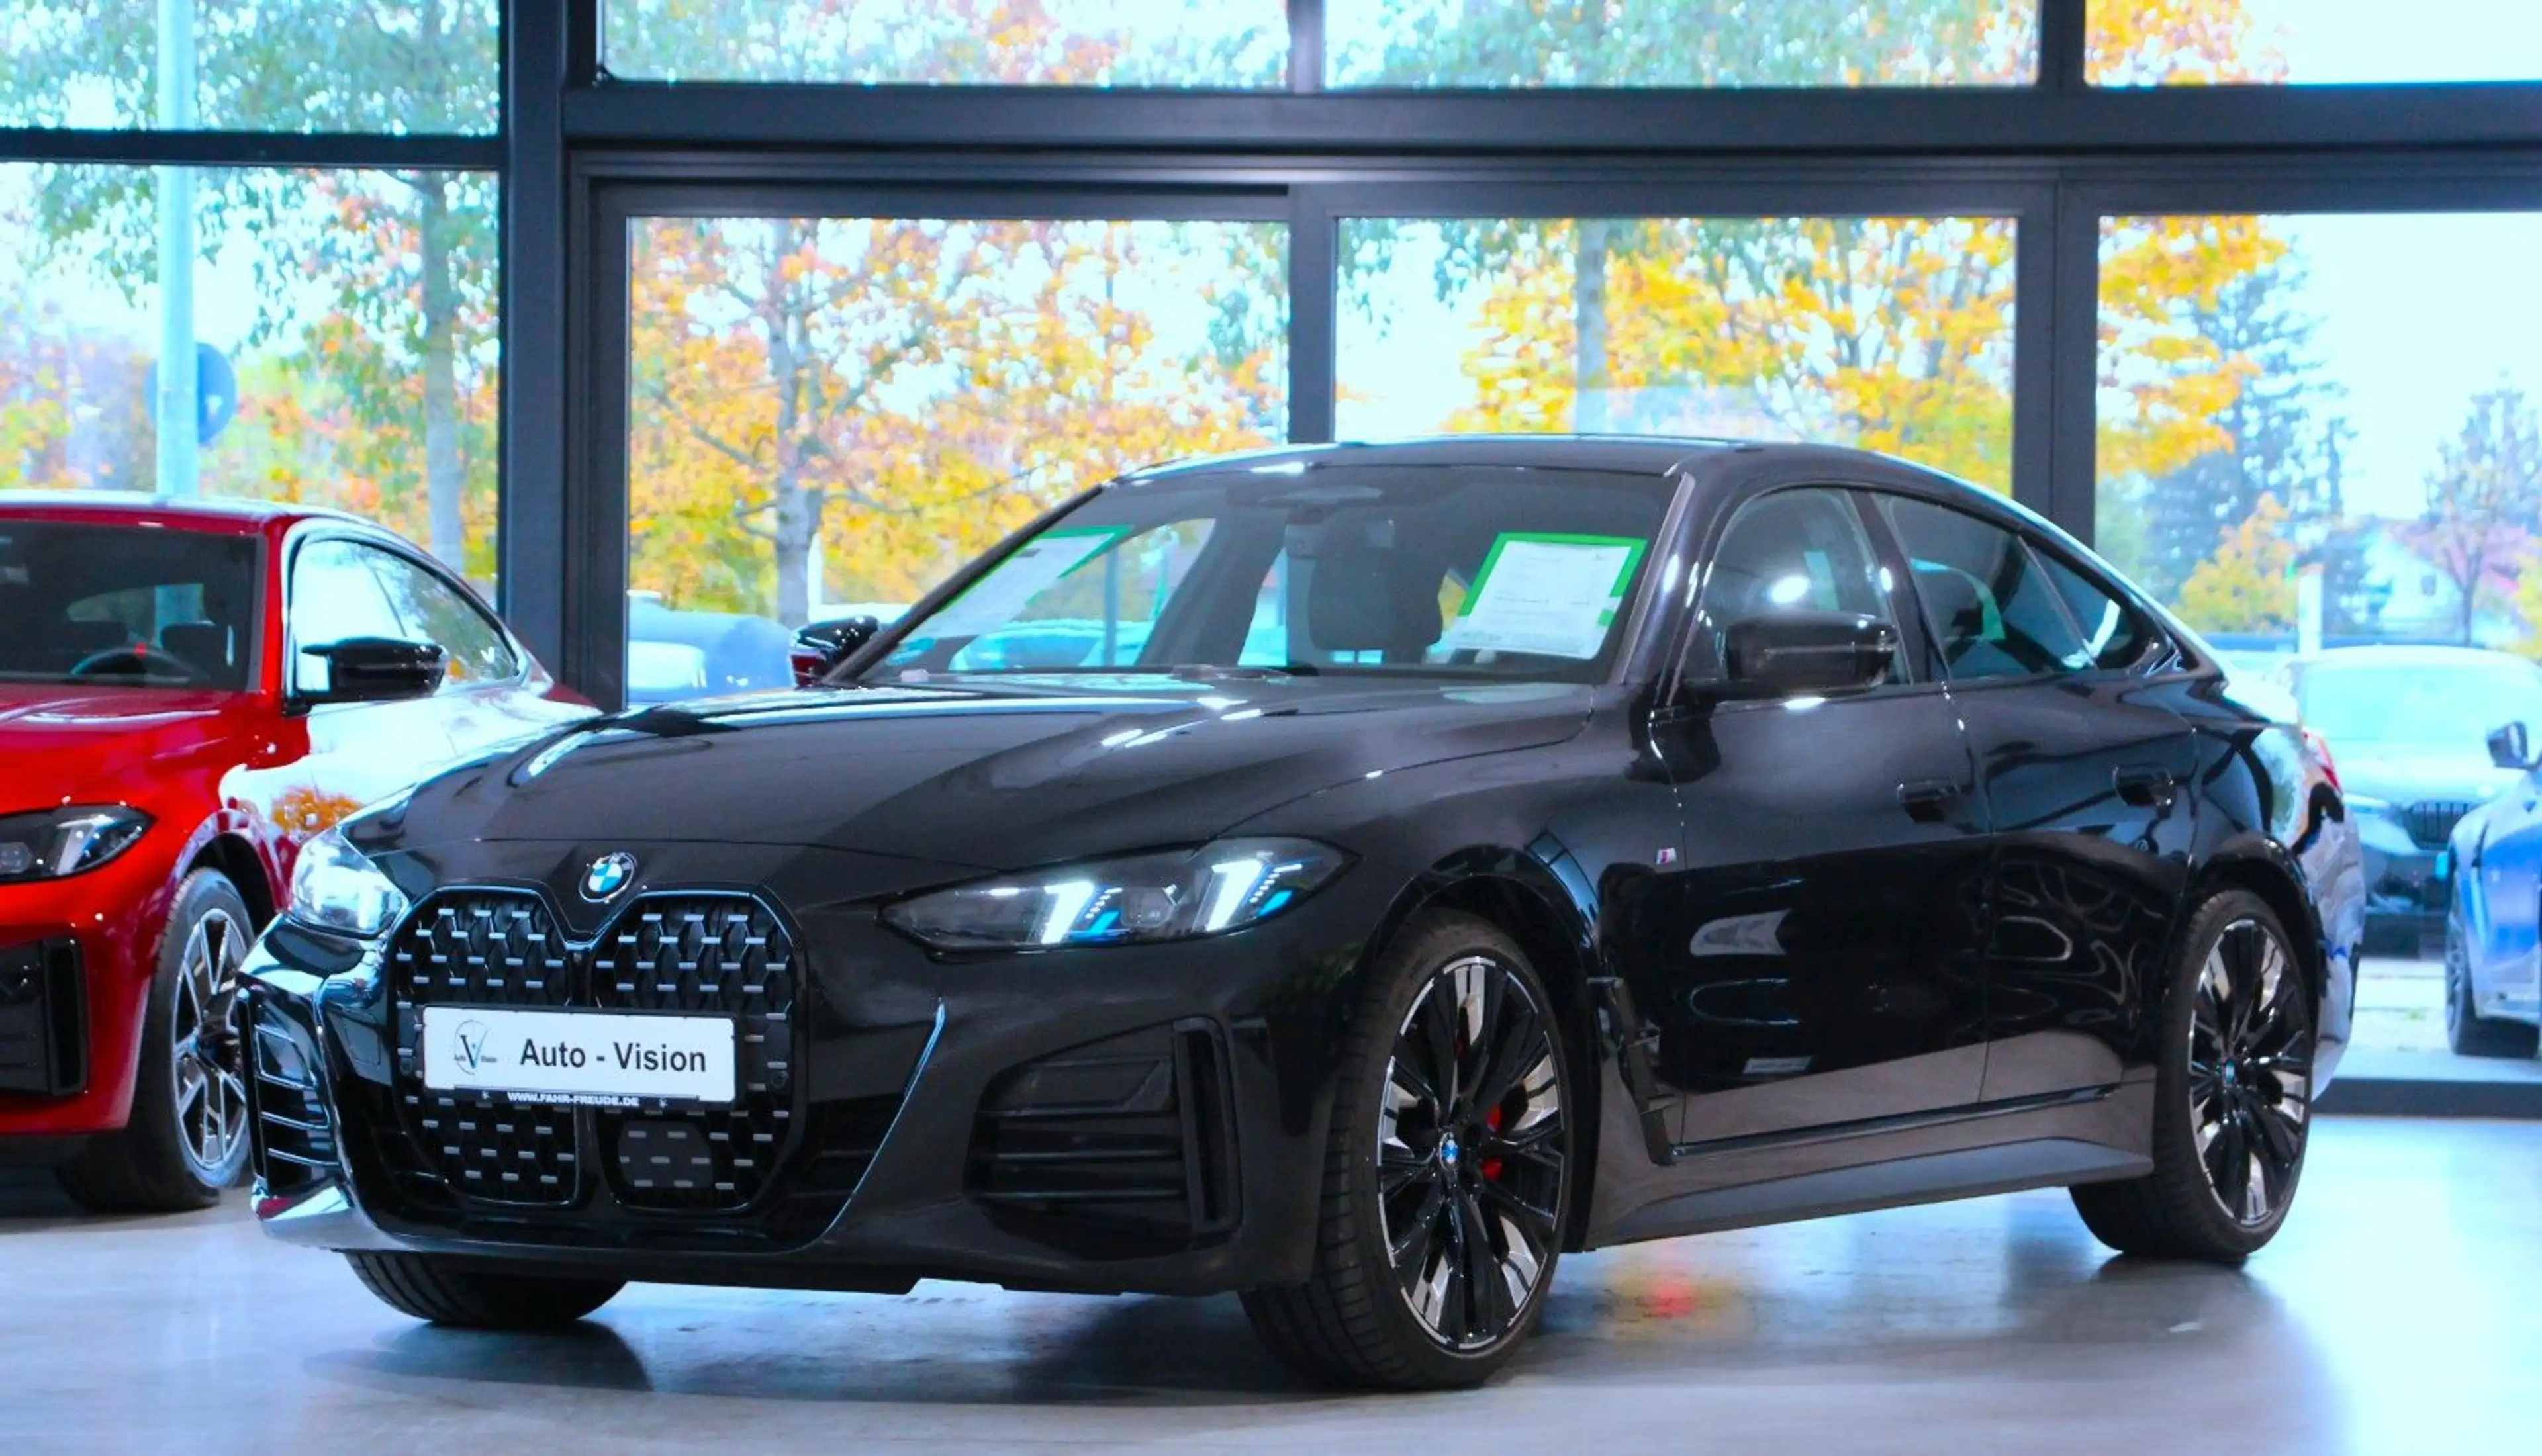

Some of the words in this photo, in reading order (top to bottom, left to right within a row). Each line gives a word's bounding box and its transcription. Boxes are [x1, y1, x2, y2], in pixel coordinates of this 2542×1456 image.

[520, 1038, 586, 1068] Auto
[614, 1042, 706, 1072] Vision
[507, 1092, 639, 1107] WWW.FAHR-FREUDE.DE
